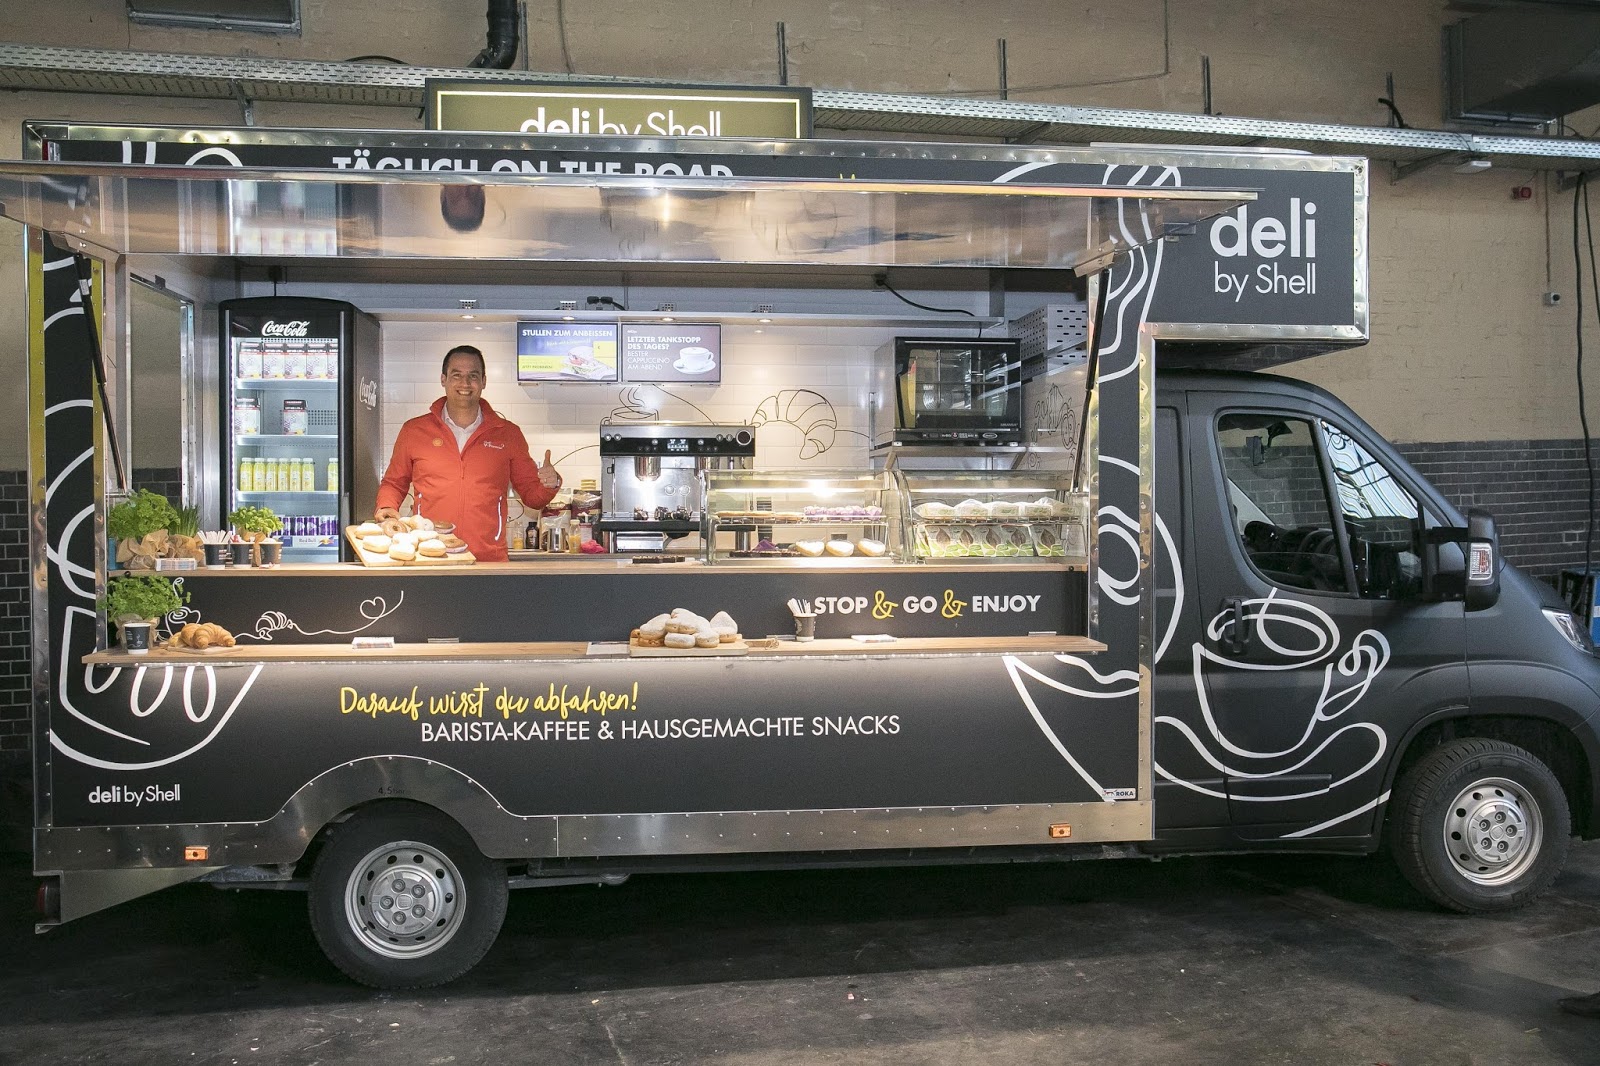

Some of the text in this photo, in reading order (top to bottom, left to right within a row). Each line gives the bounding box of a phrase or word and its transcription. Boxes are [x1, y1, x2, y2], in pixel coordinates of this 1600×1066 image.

[520, 107, 590, 134] deli
[1209, 197, 1317, 258] deli
[1214, 261, 1316, 302] by Shell
[261, 320, 310, 337] Coca-Cola
[657, 336, 701, 344] TANKSTOPP
[814, 589, 1041, 620] STOP & GO & ENJOY
[340, 681, 638, 721] Darauf wirst du abfahren!
[421, 715, 900, 742] BARISTA-KAFFEE & HAUSGEMACHTE SNACKS
[88, 784, 180, 807] deli by Shell
